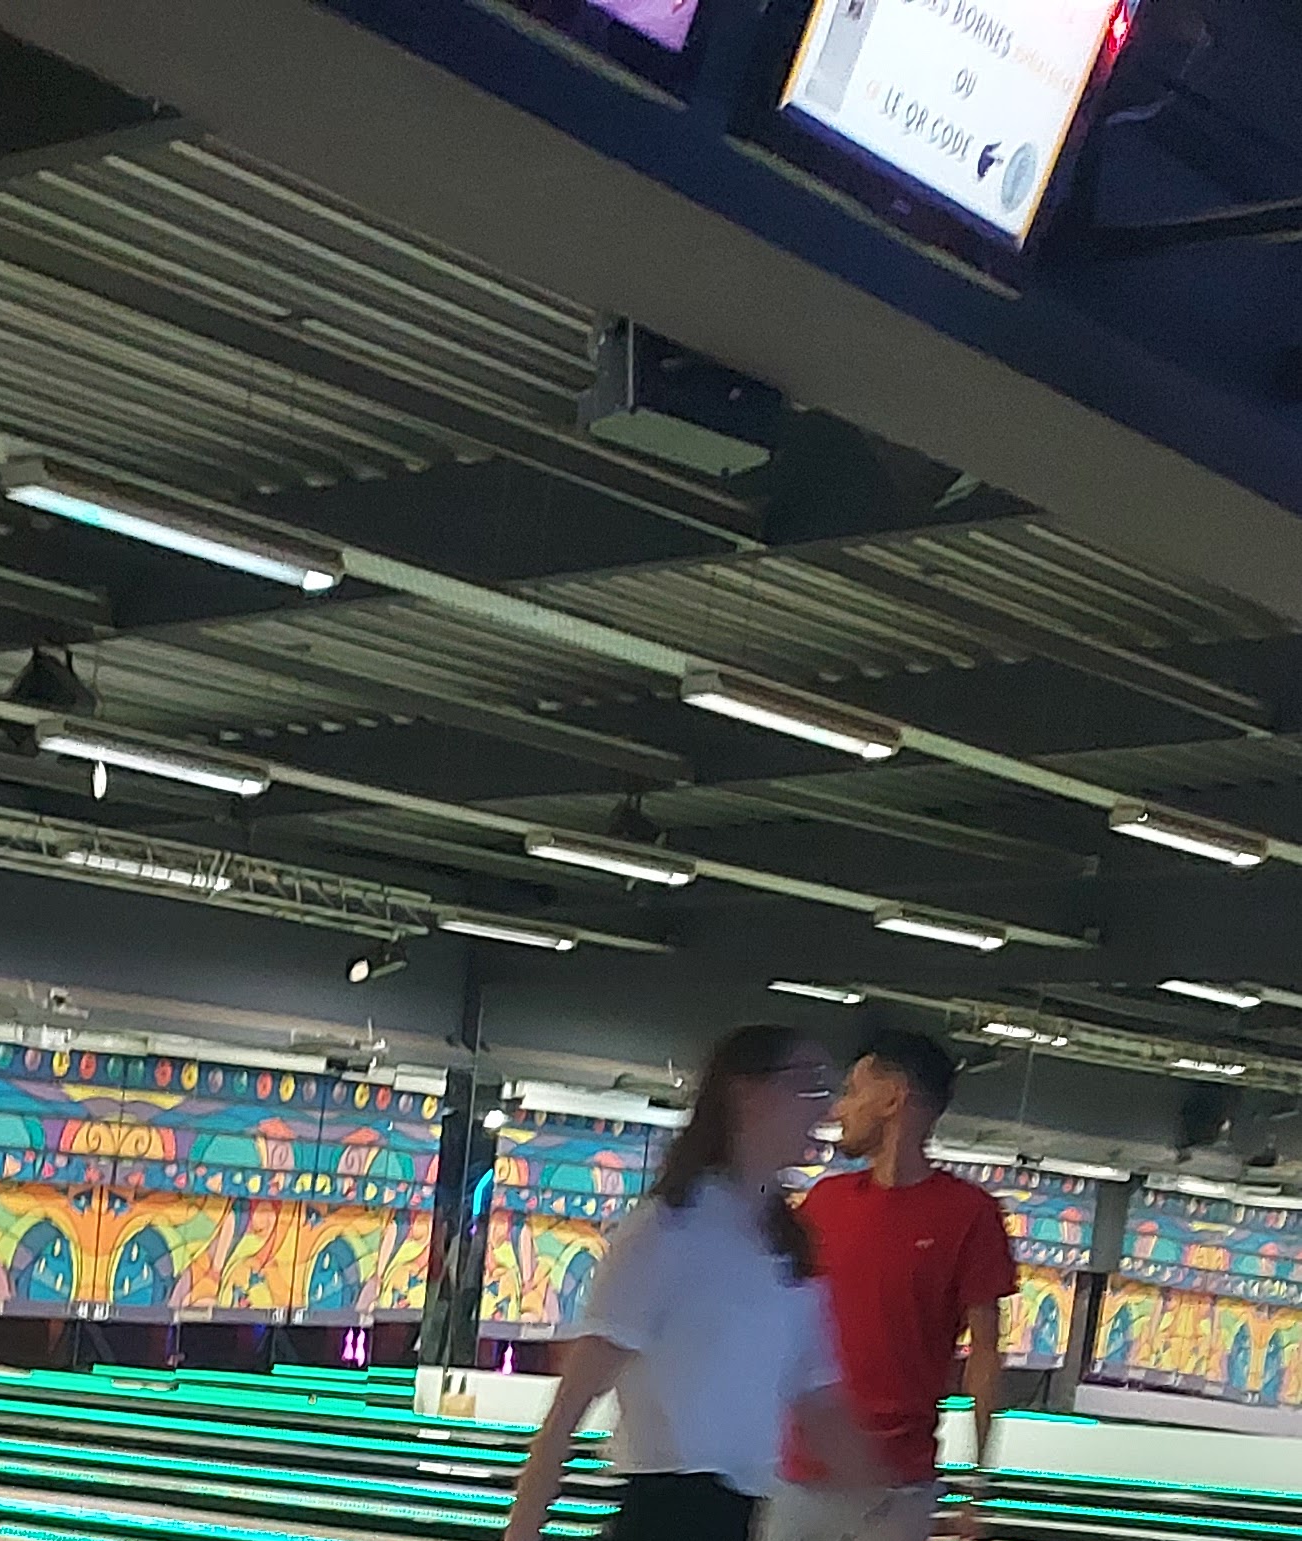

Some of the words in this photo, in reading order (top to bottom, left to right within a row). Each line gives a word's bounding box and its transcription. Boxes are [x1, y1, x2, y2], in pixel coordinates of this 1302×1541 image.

[952, 0, 1014, 58] BORNES
[953, 67, 978, 100] OU
[880, 85, 904, 119] LE
[904, 100, 929, 134] QR
[929, 116, 975, 161] CODE
